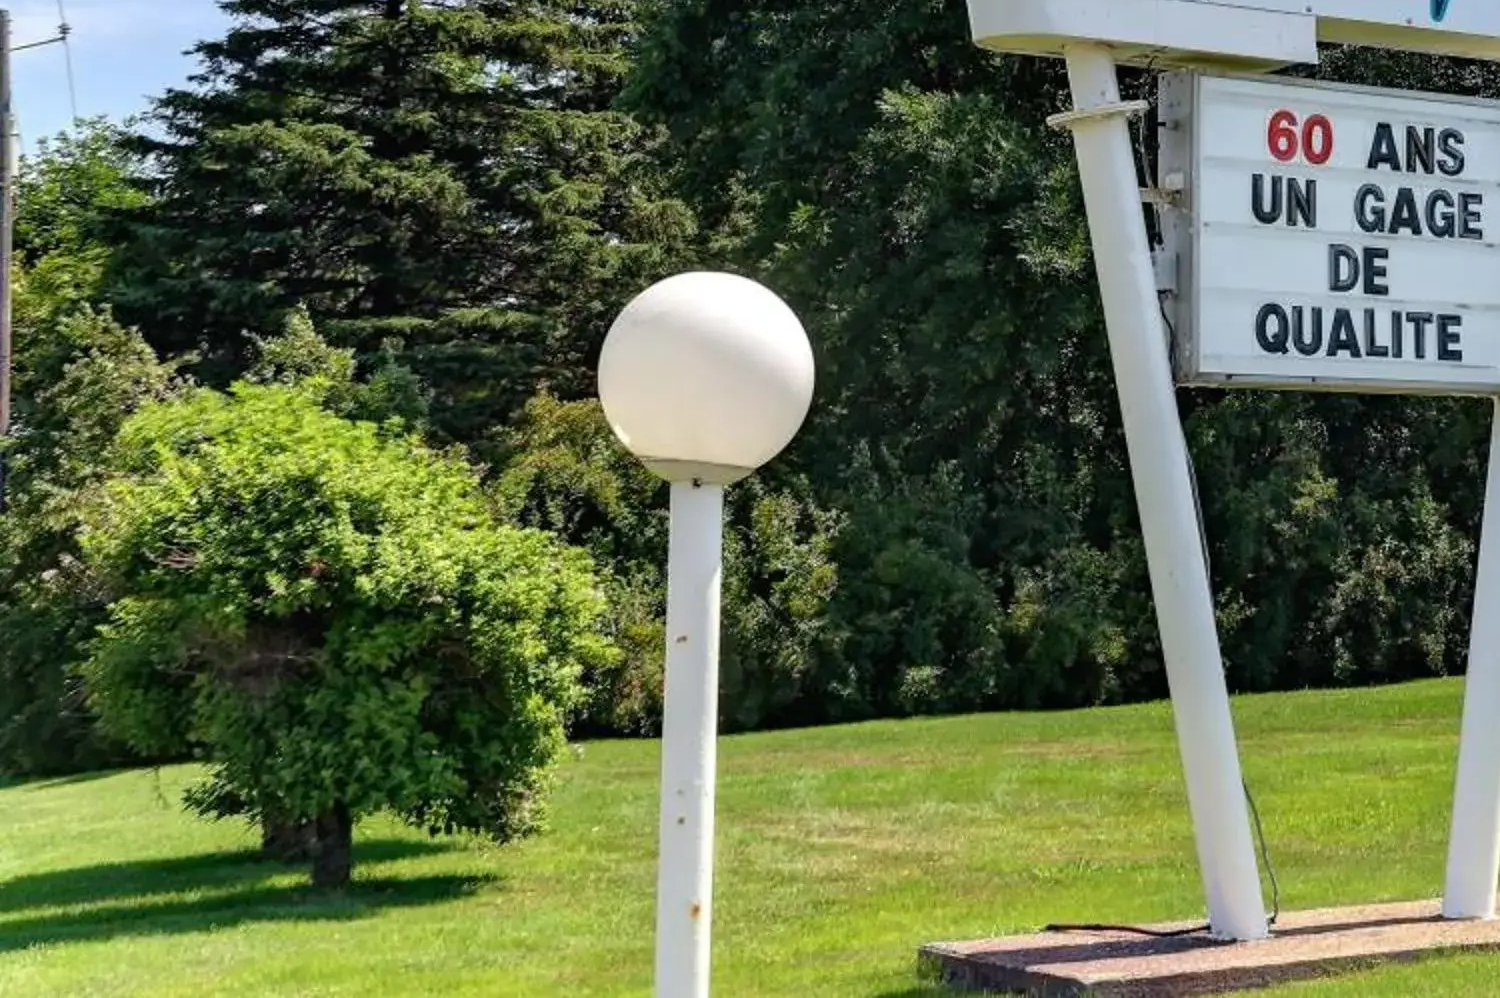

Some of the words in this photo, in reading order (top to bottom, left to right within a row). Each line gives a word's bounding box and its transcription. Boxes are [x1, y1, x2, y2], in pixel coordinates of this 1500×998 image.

[1267, 109, 1334, 165] 60
[1367, 122, 1465, 177] ANS
[1251, 173, 1317, 228] UN
[1354, 183, 1483, 240] GAGE
[1328, 243, 1389, 295] DE
[1255, 302, 1463, 362] QUALITE
